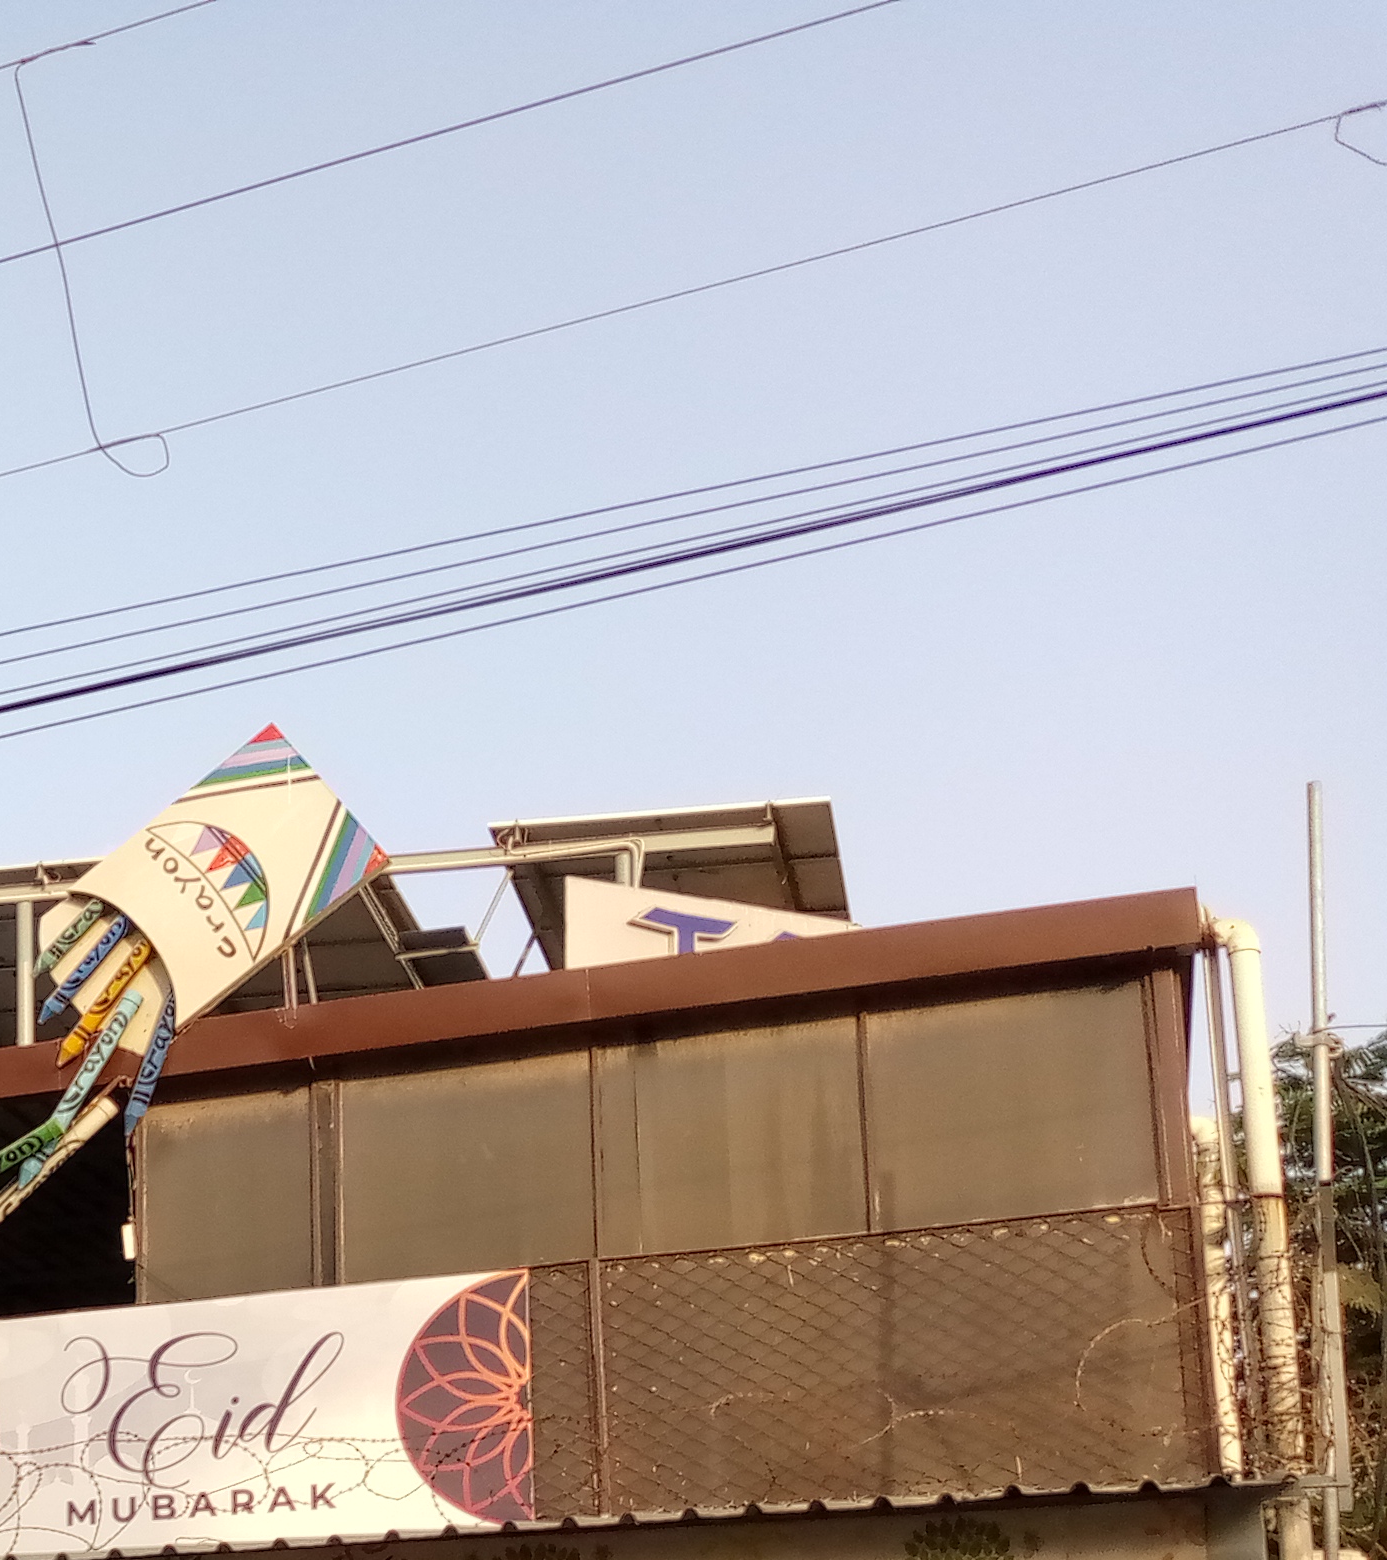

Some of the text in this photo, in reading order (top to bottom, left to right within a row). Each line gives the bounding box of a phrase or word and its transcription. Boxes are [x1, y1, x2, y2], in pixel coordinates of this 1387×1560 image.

[144, 837, 237, 959] crayon
[61, 1331, 344, 1489] Eid
[66, 1482, 338, 1527] MUBARAK
